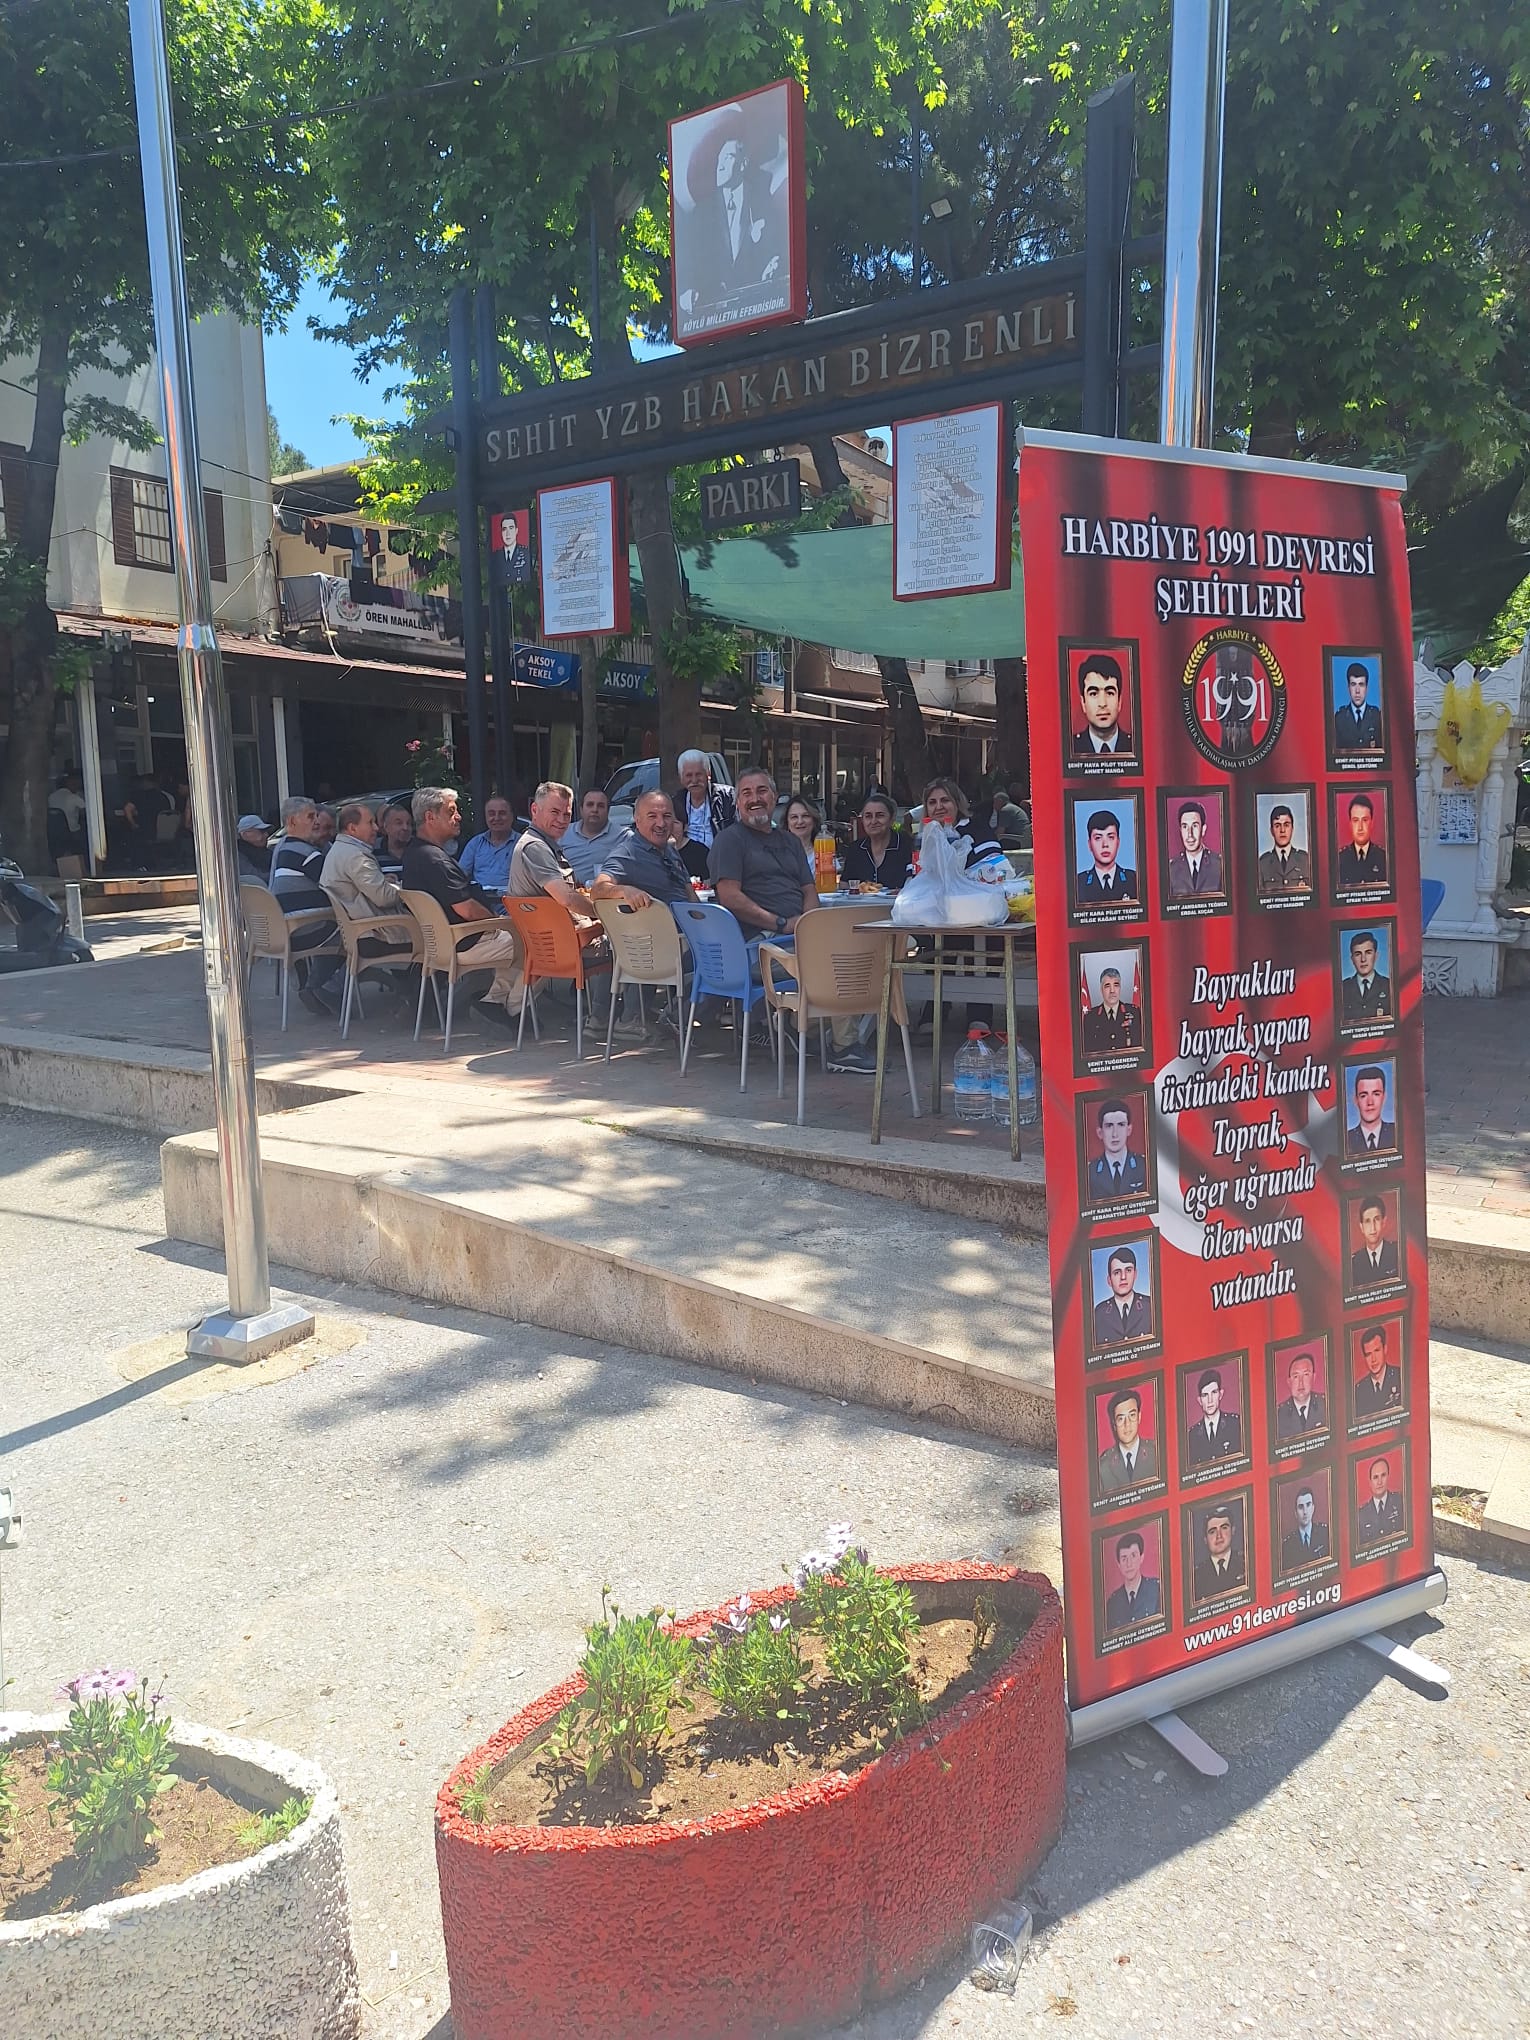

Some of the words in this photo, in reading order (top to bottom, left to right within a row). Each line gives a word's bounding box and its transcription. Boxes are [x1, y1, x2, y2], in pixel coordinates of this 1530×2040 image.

[683, 316, 705, 331] KÖYLÜ
[706, 309, 740, 326] MİLLETİN
[740, 296, 786, 318] EFENDİSİDİR.
[595, 396, 662, 440] YZB
[682, 355, 827, 424] HAKAN
[850, 291, 1076, 386] BİZRENLİ
[706, 471, 790, 519] PARKI
[1063, 515, 1199, 561] HARBİYE
[1206, 530, 1257, 567] 1991
[1264, 535, 1376, 575] DEVRESİ
[1156, 572, 1303, 621] ŞEHİTLERİ
[365, 609, 388, 625] ÖREN
[1216, 629, 1250, 641] HARBİYE
[527, 654, 556, 668] AKSOY
[528, 666, 553, 680] TEKEL
[604, 671, 641, 689] AKSOY
[1200, 675, 1268, 721] 1991
[1068, 762, 1083, 770] ŞEHİT
[1117, 760, 1138, 768] TEĞMEN
[1192, 959, 1295, 1011] Bayrakları
[1179, 1013, 1248, 1065] bayrak
[1250, 1016, 1310, 1058] yapan
[1104, 1056, 1139, 1065] TUĞGENERAL
[1111, 1062, 1137, 1070] ERDOĞAN
[1161, 1062, 1259, 1113] üstündeki
[1264, 1055, 1330, 1096] kandır.
[1214, 1111, 1287, 1162] Toprak,
[1129, 1200, 1156, 1209] ÜSTEĞMEN
[1184, 1172, 1228, 1220] eğer
[1234, 1156, 1316, 1210] uğrunda
[1202, 1221, 1246, 1260] ölen
[1251, 1216, 1303, 1251] varsa
[1211, 1260, 1297, 1310] vatandır.
[1133, 1342, 1161, 1352] ÜSTEĞMEN
[1109, 1490, 1137, 1502] JANDARMA
[1137, 1482, 1166, 1494] ÜSTEĞMEN
[1118, 1498, 1130, 1506] CEM
[1184, 1583, 1341, 1651] www.91devresi.org
